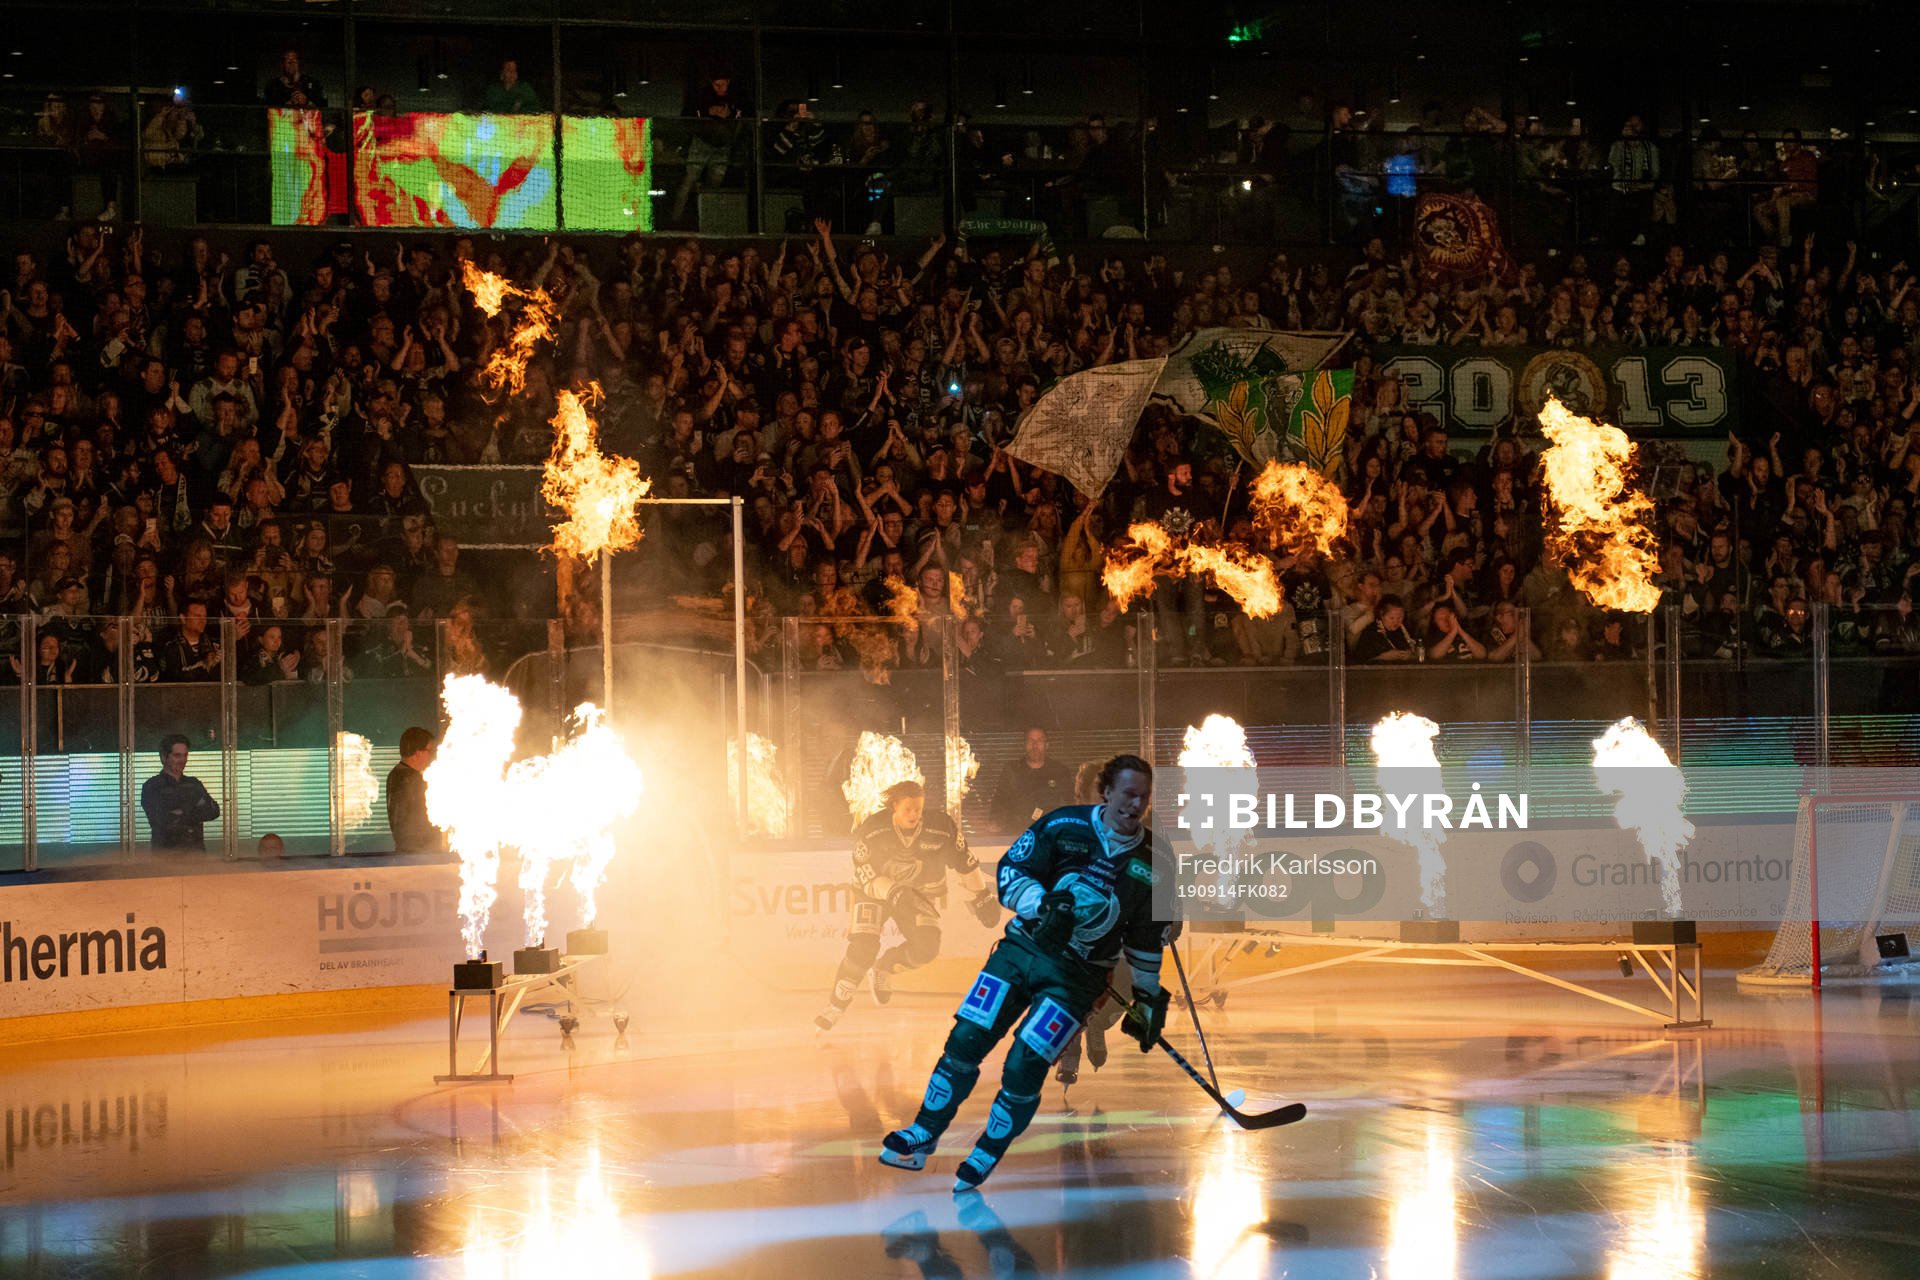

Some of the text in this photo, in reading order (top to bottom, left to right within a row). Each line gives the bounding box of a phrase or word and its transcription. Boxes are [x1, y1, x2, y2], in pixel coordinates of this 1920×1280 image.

[420, 475, 541, 528] Lucky
[1571, 850, 1796, 887] Grant hornto
[318, 882, 458, 932] HÖJDE
[0, 912, 167, 982] hermia
